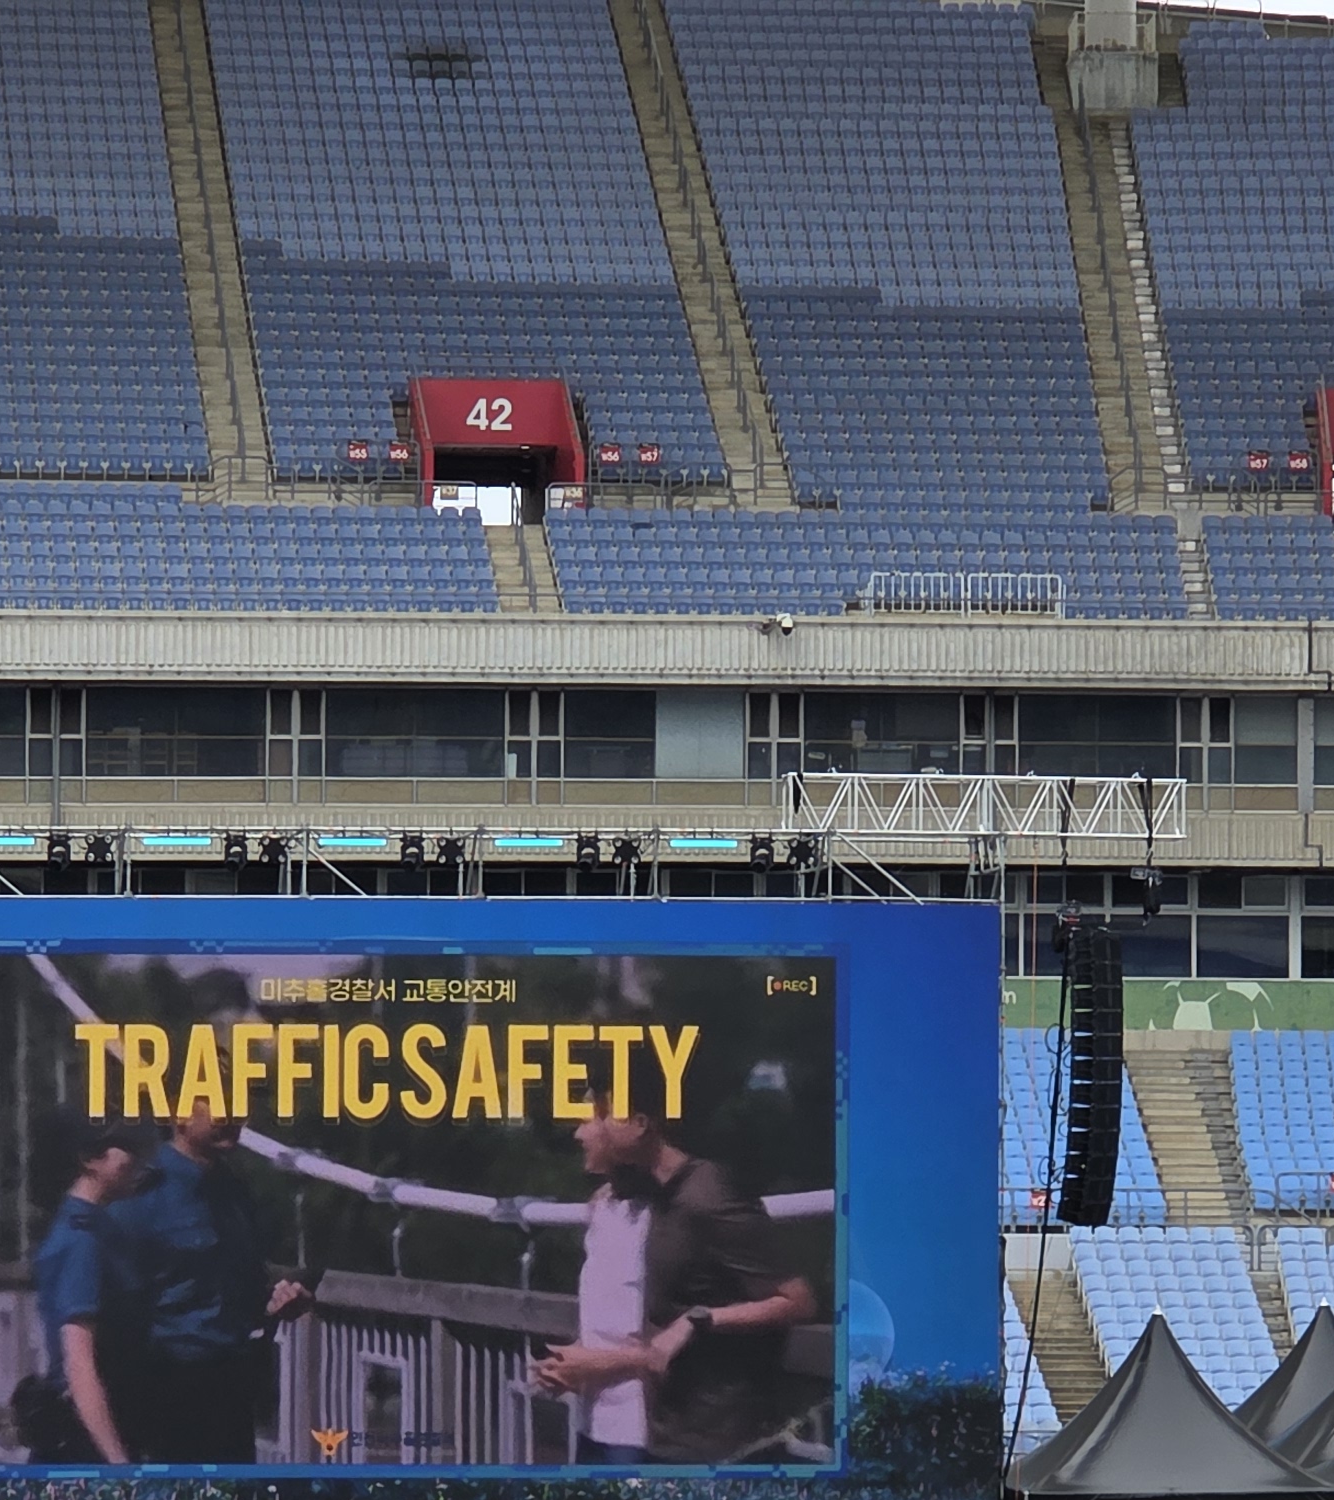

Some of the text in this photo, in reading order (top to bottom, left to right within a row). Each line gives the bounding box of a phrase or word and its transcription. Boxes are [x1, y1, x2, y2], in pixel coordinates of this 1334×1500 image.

[466, 398, 513, 431] 42
[260, 978, 517, 1003] 미추홀경찰서 교통안전계
